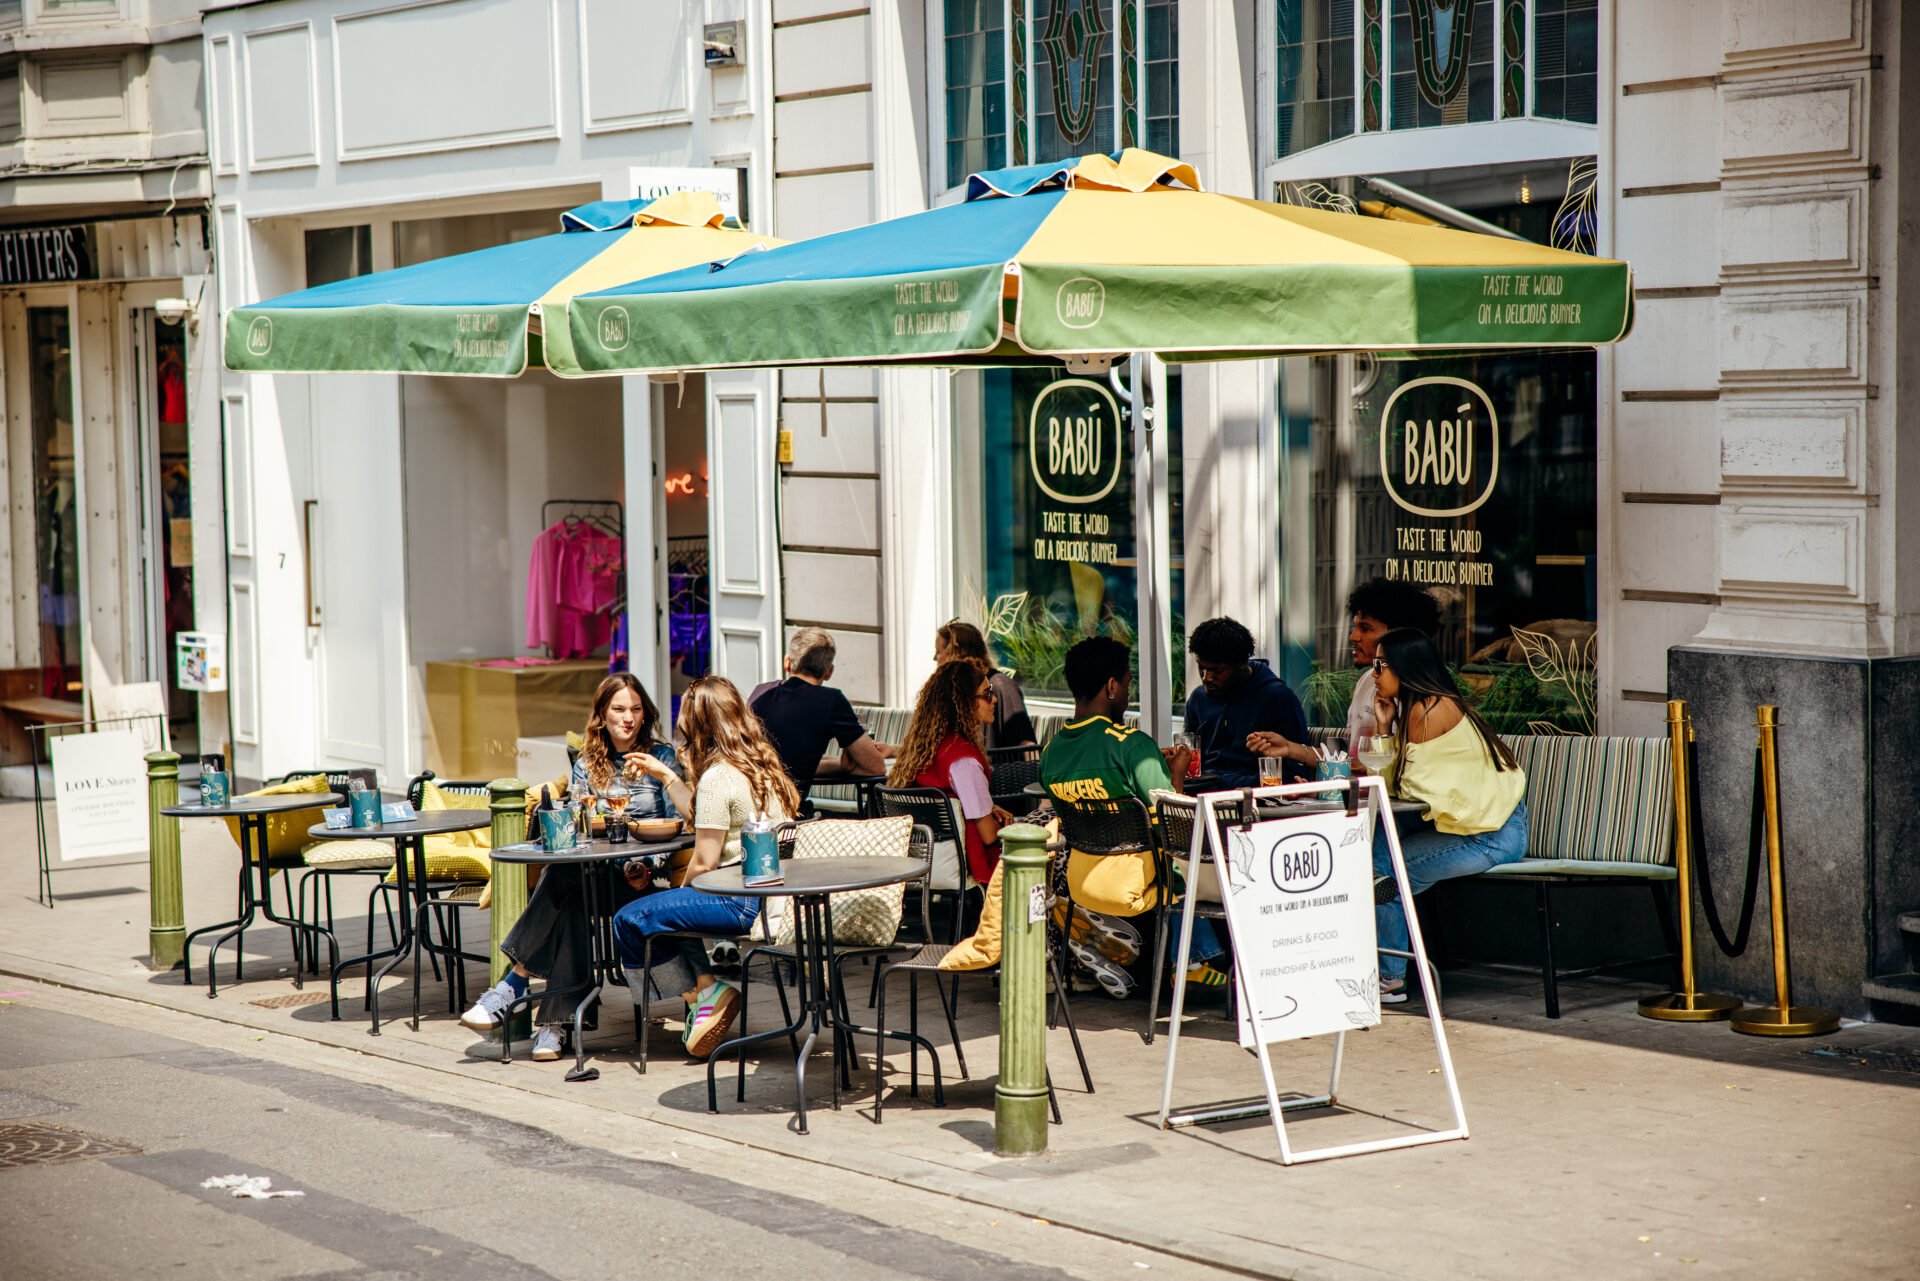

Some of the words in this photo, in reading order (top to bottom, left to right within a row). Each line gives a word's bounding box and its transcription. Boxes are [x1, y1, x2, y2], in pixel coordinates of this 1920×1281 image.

[0, 228, 79, 282] FITTERS
[895, 283, 917, 305] TASTE
[919, 282, 932, 304] THE
[934, 280, 959, 303] WORLD
[1482, 275, 1511, 296] TASTE
[1514, 275, 1530, 296] THE
[1533, 275, 1563, 296] WORLD
[1066, 286, 1096, 318] BABÚ
[1478, 304, 1492, 325] ON
[1494, 304, 1502, 325] A
[1505, 303, 1547, 325] DELICIOUS
[1550, 303, 1581, 325] BUNNER
[605, 313, 624, 342] BABÚ
[907, 313, 914, 335] A
[1049, 402, 1102, 476] BABÚ
[1405, 402, 1473, 486] BABÚ
[1042, 512, 1066, 534] TASTE
[1068, 513, 1082, 534] THE
[1083, 514, 1109, 536] WORLD
[1034, 538, 1046, 560] ON
[1047, 539, 1055, 561] A
[1056, 540, 1089, 563] DELICIOUS
[1091, 542, 1118, 565] BUNNER
[1396, 527, 1426, 552] TASTE
[1429, 528, 1446, 552] THE
[1449, 529, 1482, 554] WORLD
[278, 552, 286, 569] 7
[1385, 558, 1399, 582] ON
[1402, 558, 1410, 582] A
[1413, 560, 1456, 585] DELICIOUS
[1459, 562, 1494, 586] BUNNER
[65, 777, 105, 793] LOVE
[1283, 842, 1320, 881] BABÚ
[1260, 904, 1273, 915] TASTE
[1275, 903, 1283, 912] THE
[1284, 901, 1299, 911] WORLD
[1272, 935, 1304, 949] DRINKS
[1304, 932, 1312, 943] &
[1313, 930, 1338, 942] FOOD
[1260, 961, 1309, 978] FRIENDSHIP
[1309, 959, 1317, 970] &
[1318, 956, 1355, 969] WARMTH
